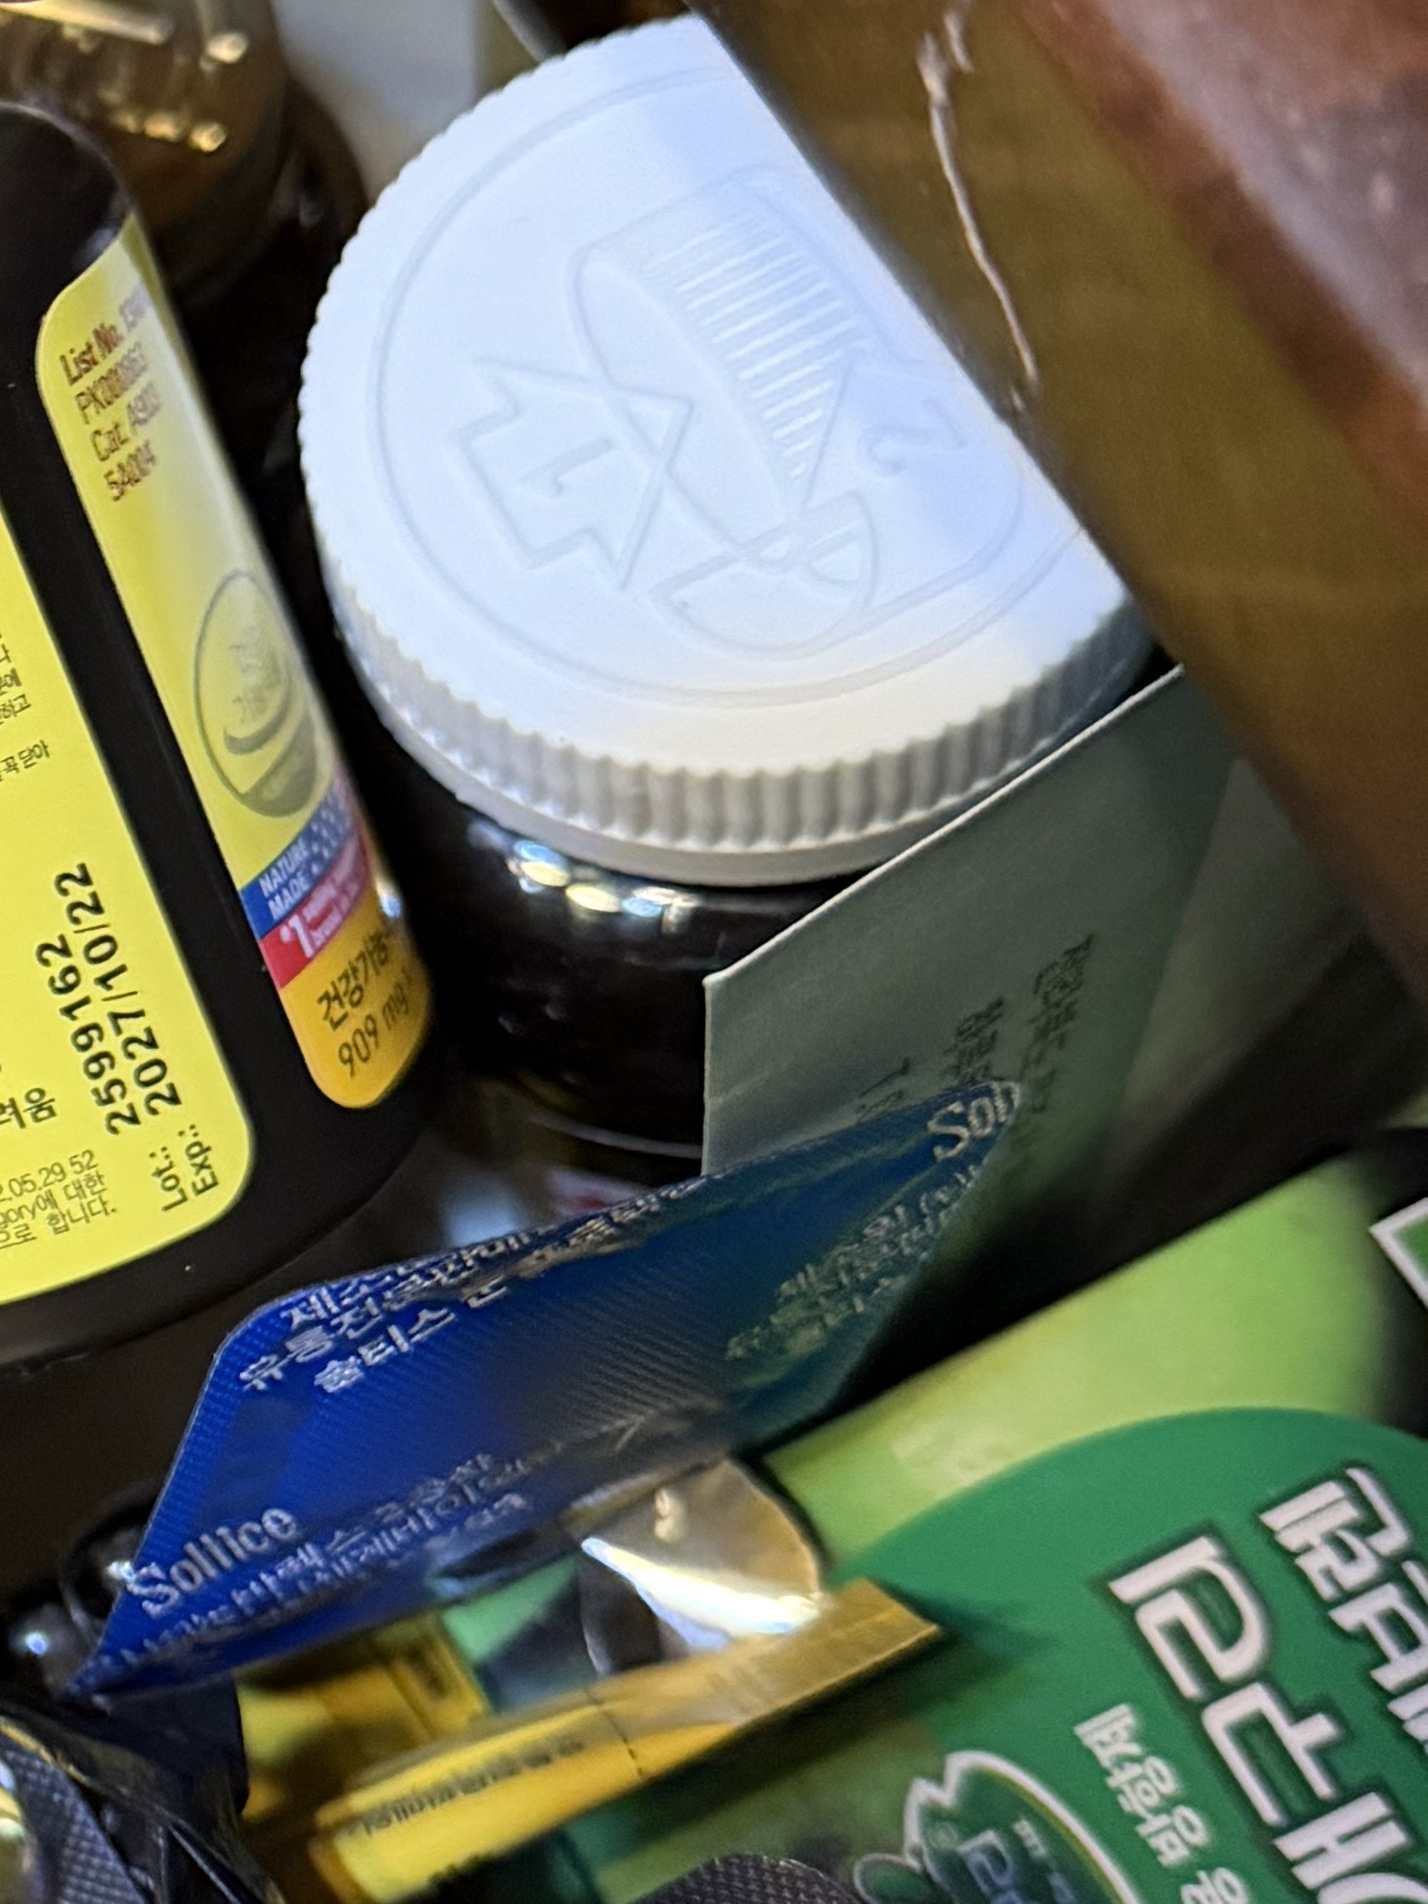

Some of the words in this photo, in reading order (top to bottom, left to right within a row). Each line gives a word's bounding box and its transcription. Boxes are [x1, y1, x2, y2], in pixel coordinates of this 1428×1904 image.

[59, 340, 99, 385] List
[257, 837, 310, 897] NATURE
[266, 870, 309, 919] MADE
[50, 860, 183, 1117] 2027/10/22
[32, 933, 141, 1136] 2599162
[334, 1012, 383, 1077] 909
[380, 987, 412, 1030] mg
[60, 1170, 108, 1203] 대한
[68, 1148, 98, 1174] 52
[46, 1195, 117, 1236] 합니다.
[127, 1504, 302, 1621] Sollice
[1061, 1690, 1221, 1875] 방향제
